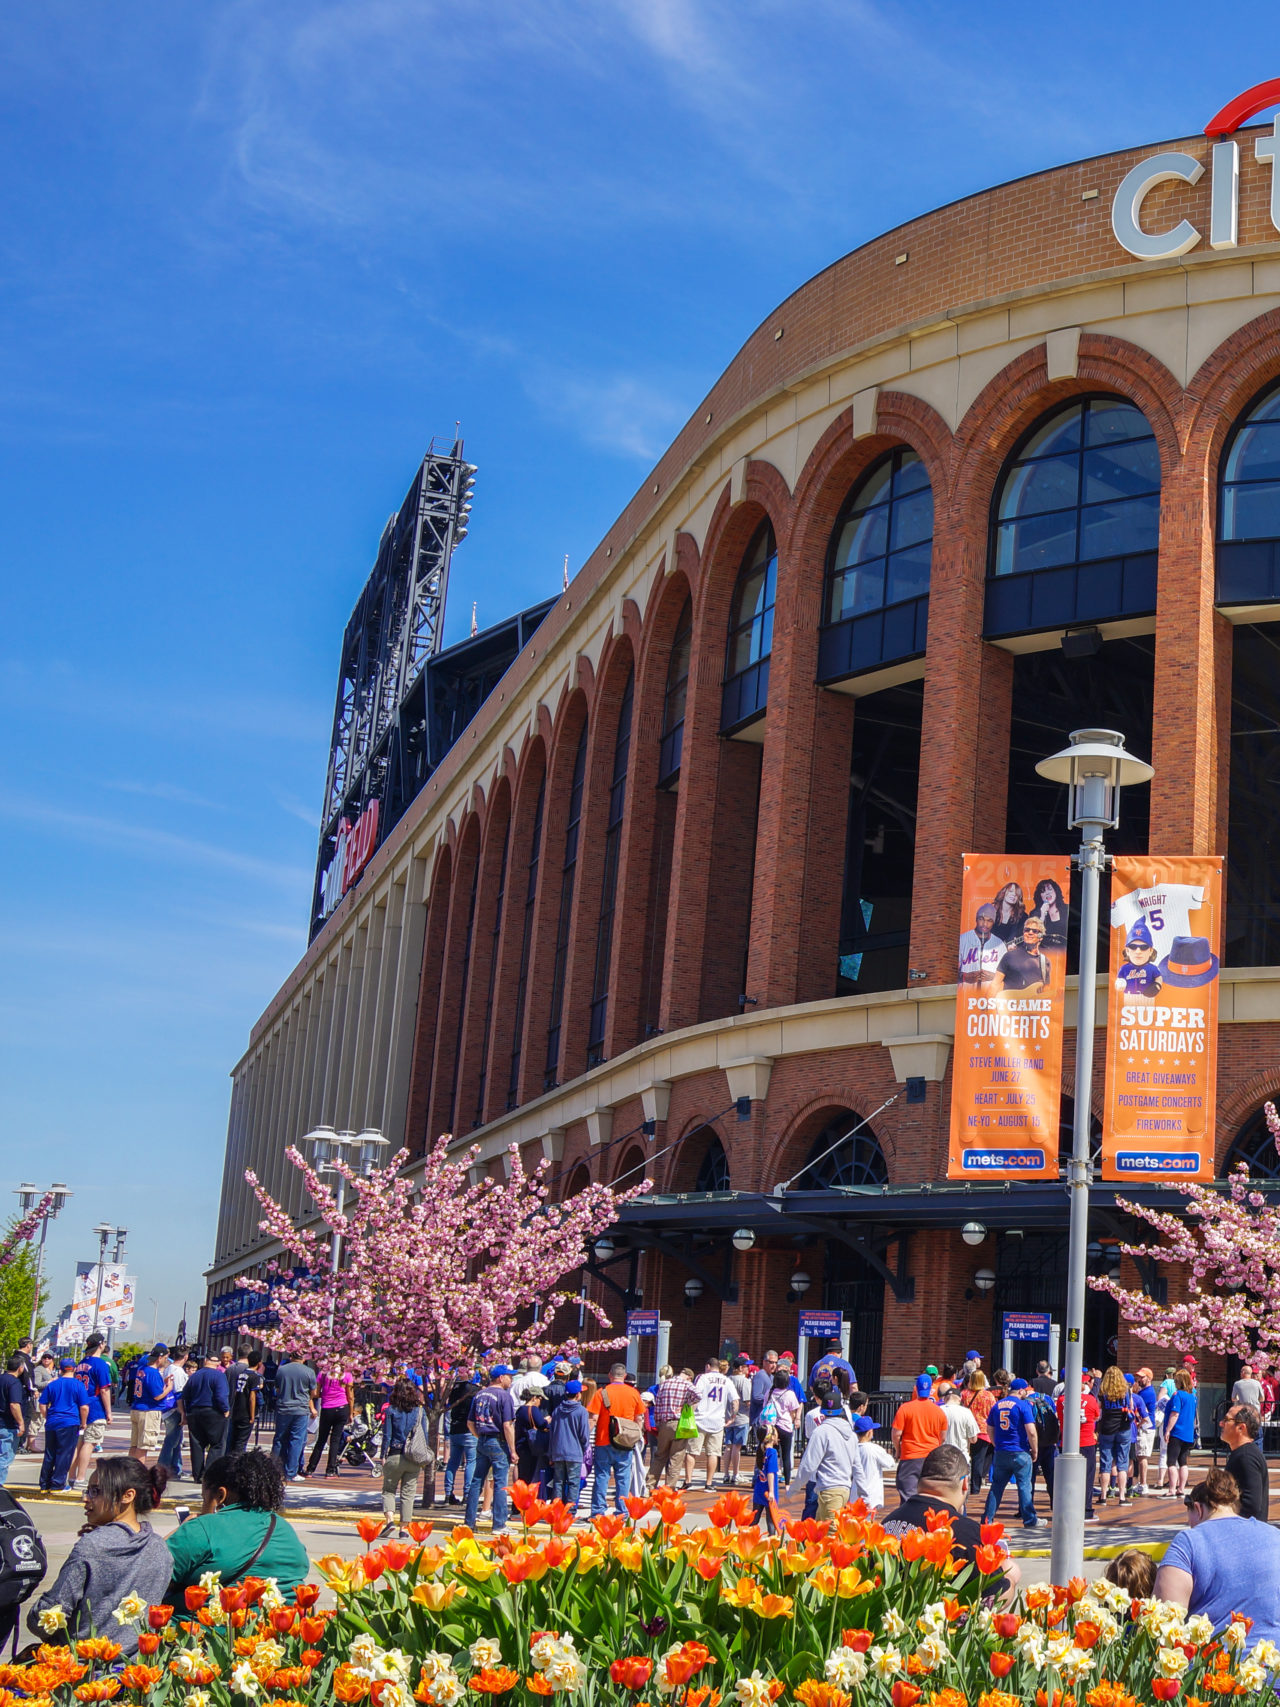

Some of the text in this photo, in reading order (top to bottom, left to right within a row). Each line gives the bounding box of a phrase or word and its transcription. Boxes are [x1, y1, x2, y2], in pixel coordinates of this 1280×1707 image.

[1138, 895, 1167, 908] WRIGHT
[1149, 908, 1165, 931] 5
[967, 997, 1052, 1011] POSTGAME
[1120, 1005, 1205, 1028] SUPER
[967, 1014, 1050, 1039] CONCERTS
[1120, 1029, 1205, 1053] SATURDAYS
[969, 1056, 1044, 1070] STEVE MILLER BAND
[990, 1071, 1021, 1082] JUNE 27
[1126, 1071, 1196, 1085] GREAT GIVEAWAYS
[974, 1093, 1036, 1105] HEART JULY 25
[1118, 1094, 1202, 1108] POSTGAME CONCERTS
[968, 1115, 1040, 1127] NE-YO AUGUST 15
[1136, 1118, 1182, 1130] FIREWORKS
[967, 1154, 1040, 1165] mets.com
[1121, 1156, 1195, 1168] mets.com
[708, 1386, 722, 1402] 41
[1000, 1411, 1009, 1430] 5
